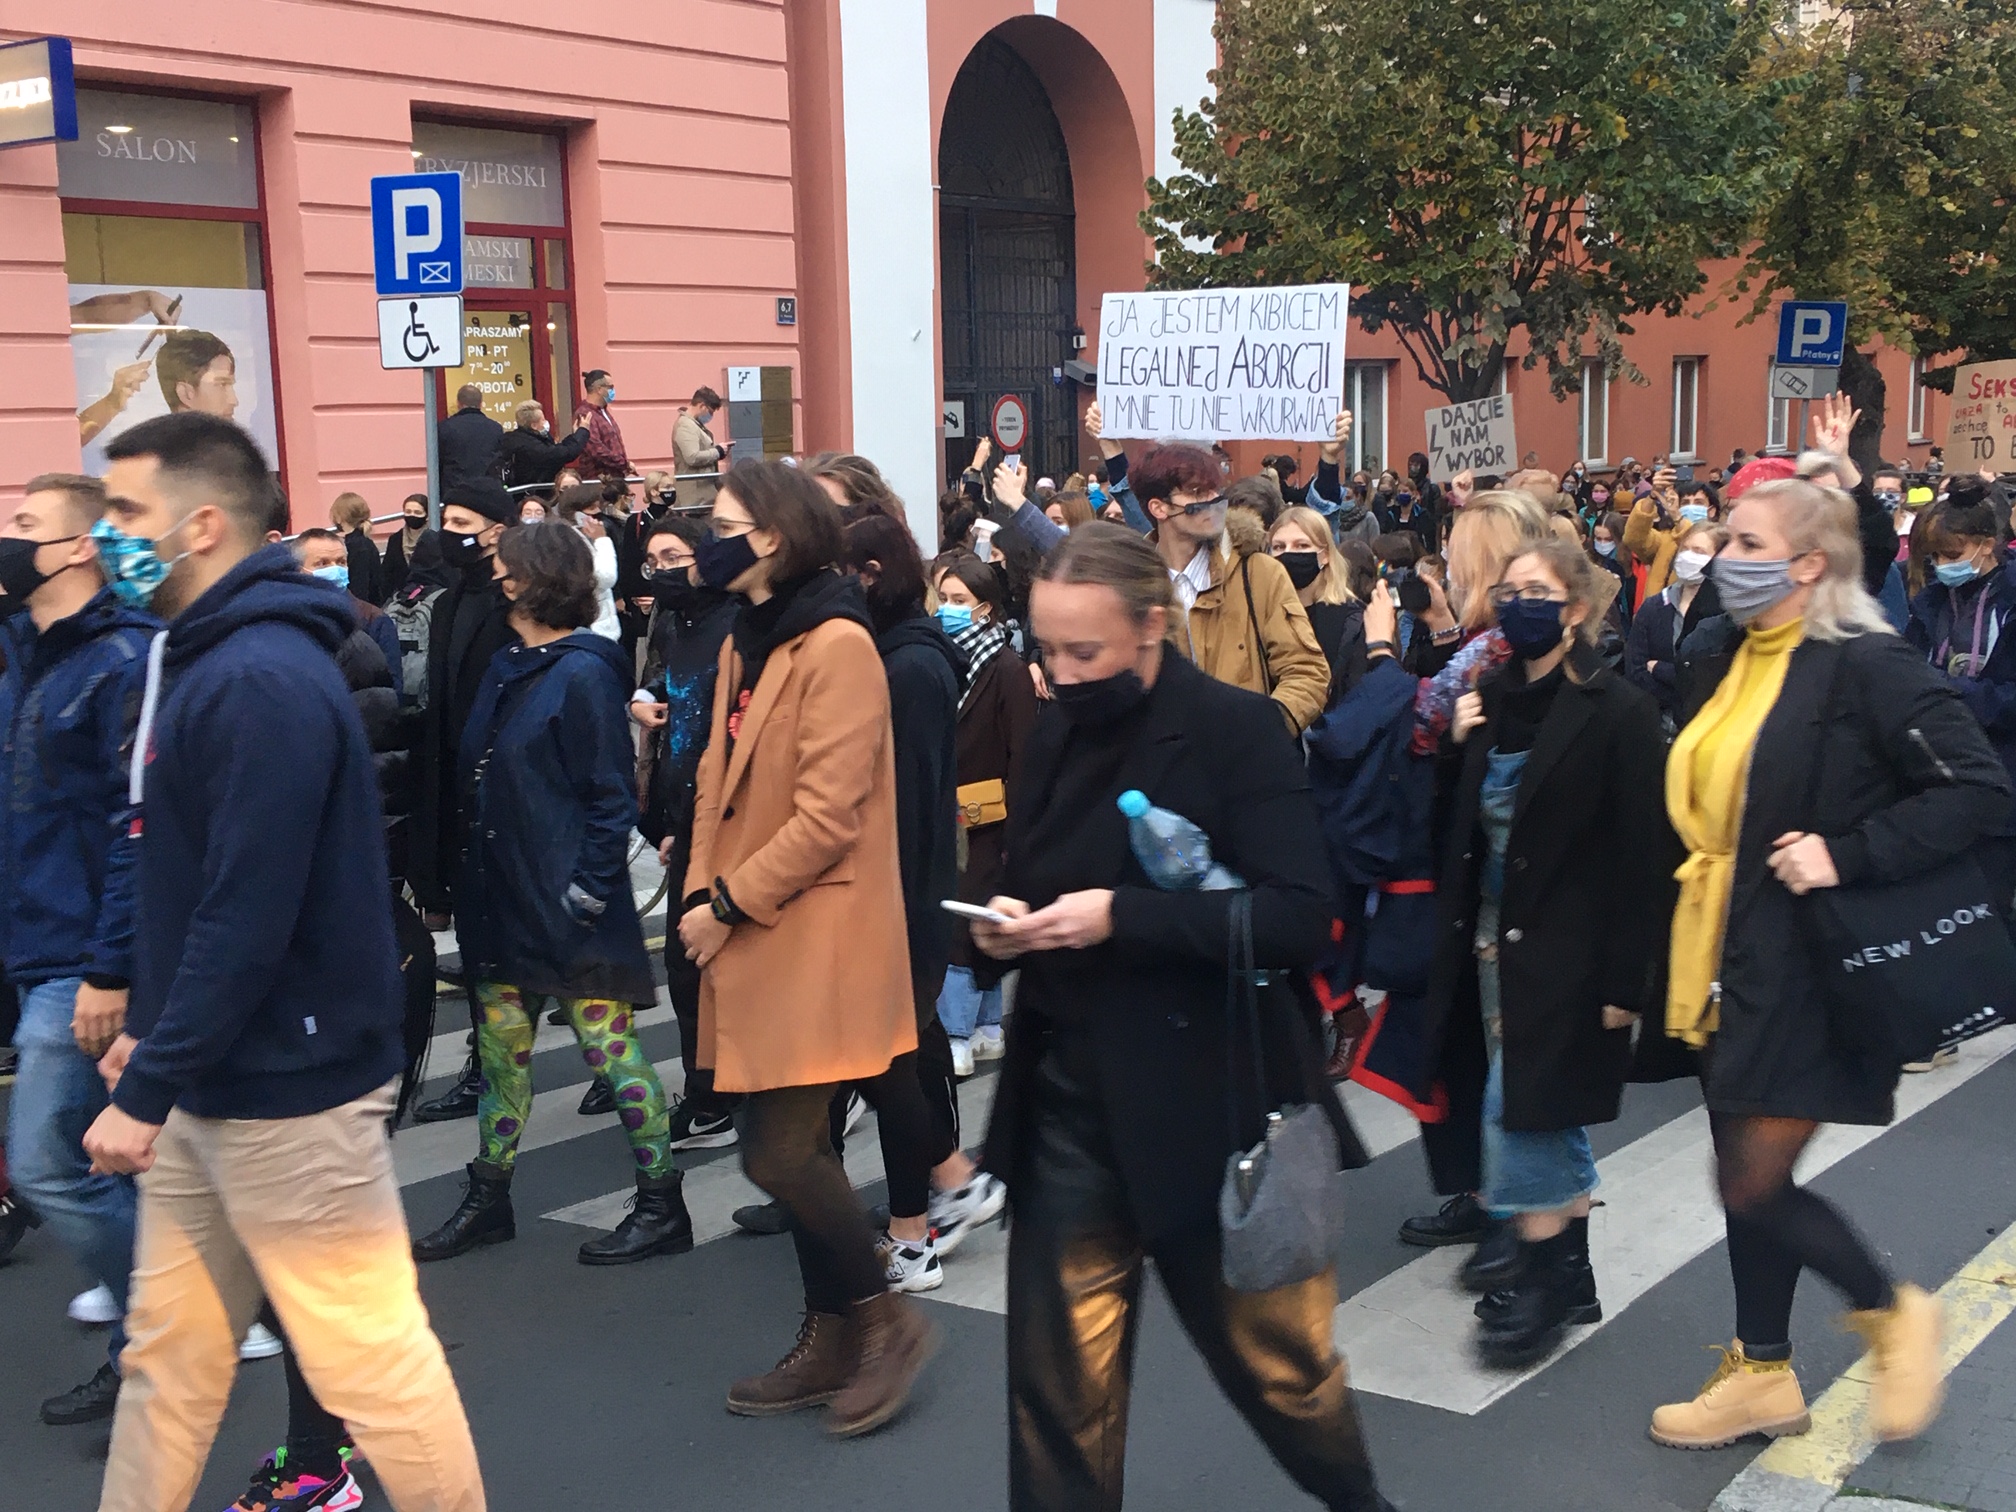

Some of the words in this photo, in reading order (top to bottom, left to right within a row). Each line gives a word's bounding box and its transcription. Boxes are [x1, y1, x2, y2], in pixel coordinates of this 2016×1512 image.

[96, 133, 196, 163] SALON
[392, 187, 442, 280] P
[465, 240, 521, 259] AMSKI
[1107, 299, 1139, 338] JA
[1150, 295, 1240, 338] JESTEM
[1249, 291, 1338, 331] KIBICEM
[464, 327, 523, 338] PRASZAMY
[1791, 308, 1832, 357] P
[467, 345, 484, 357] PN
[493, 345, 508, 357] PT
[1104, 342, 1219, 392] LEGALNEJ
[1227, 334, 1330, 393] ABORCJI
[1103, 395, 1107, 430] I
[1115, 395, 1160, 431] MNIE
[1168, 395, 1195, 431] TU
[1201, 395, 1232, 433] NIE
[1240, 393, 1340, 438] WKURWIAJ
[1441, 397, 1504, 428] DAJCIE
[2003, 414, 2016, 429] A
[1450, 424, 1489, 448] NAM
[1970, 435, 1995, 460] TO
[1445, 441, 1507, 472] WYBÓR
[1842, 940, 1911, 973] NEW
[1919, 903, 1995, 945] LOOK
